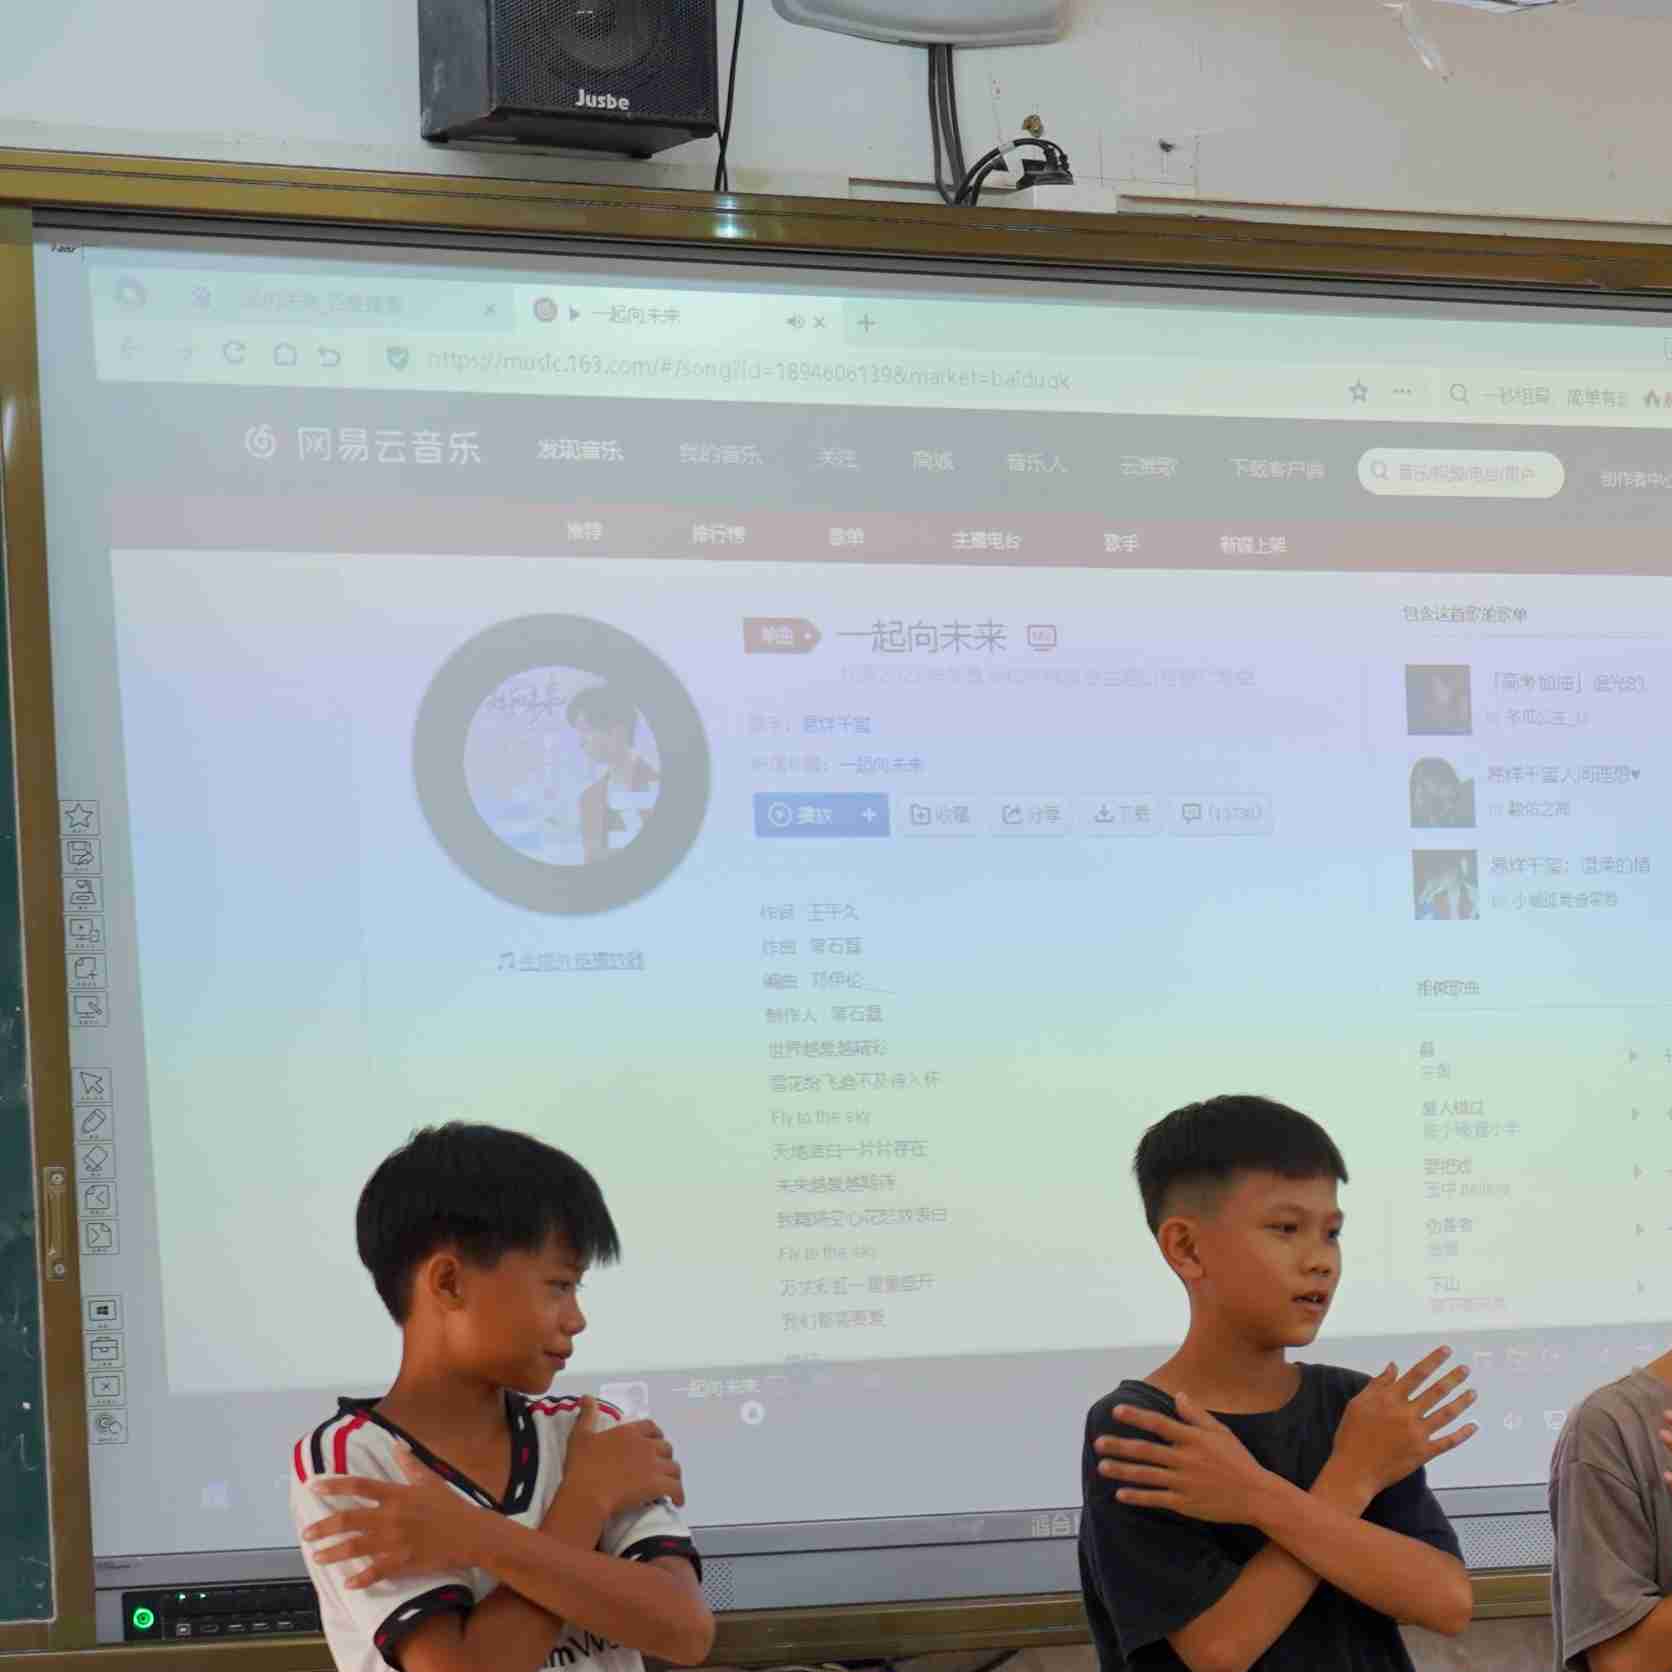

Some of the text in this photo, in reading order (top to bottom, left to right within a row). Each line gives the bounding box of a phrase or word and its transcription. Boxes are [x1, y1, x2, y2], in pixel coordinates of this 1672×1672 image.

[575, 88, 630, 113] Jusbe
[297, 425, 482, 466] 网易云音乐
[537, 437, 624, 463] 发现音乐
[837, 619, 1008, 653] 一起向未来
